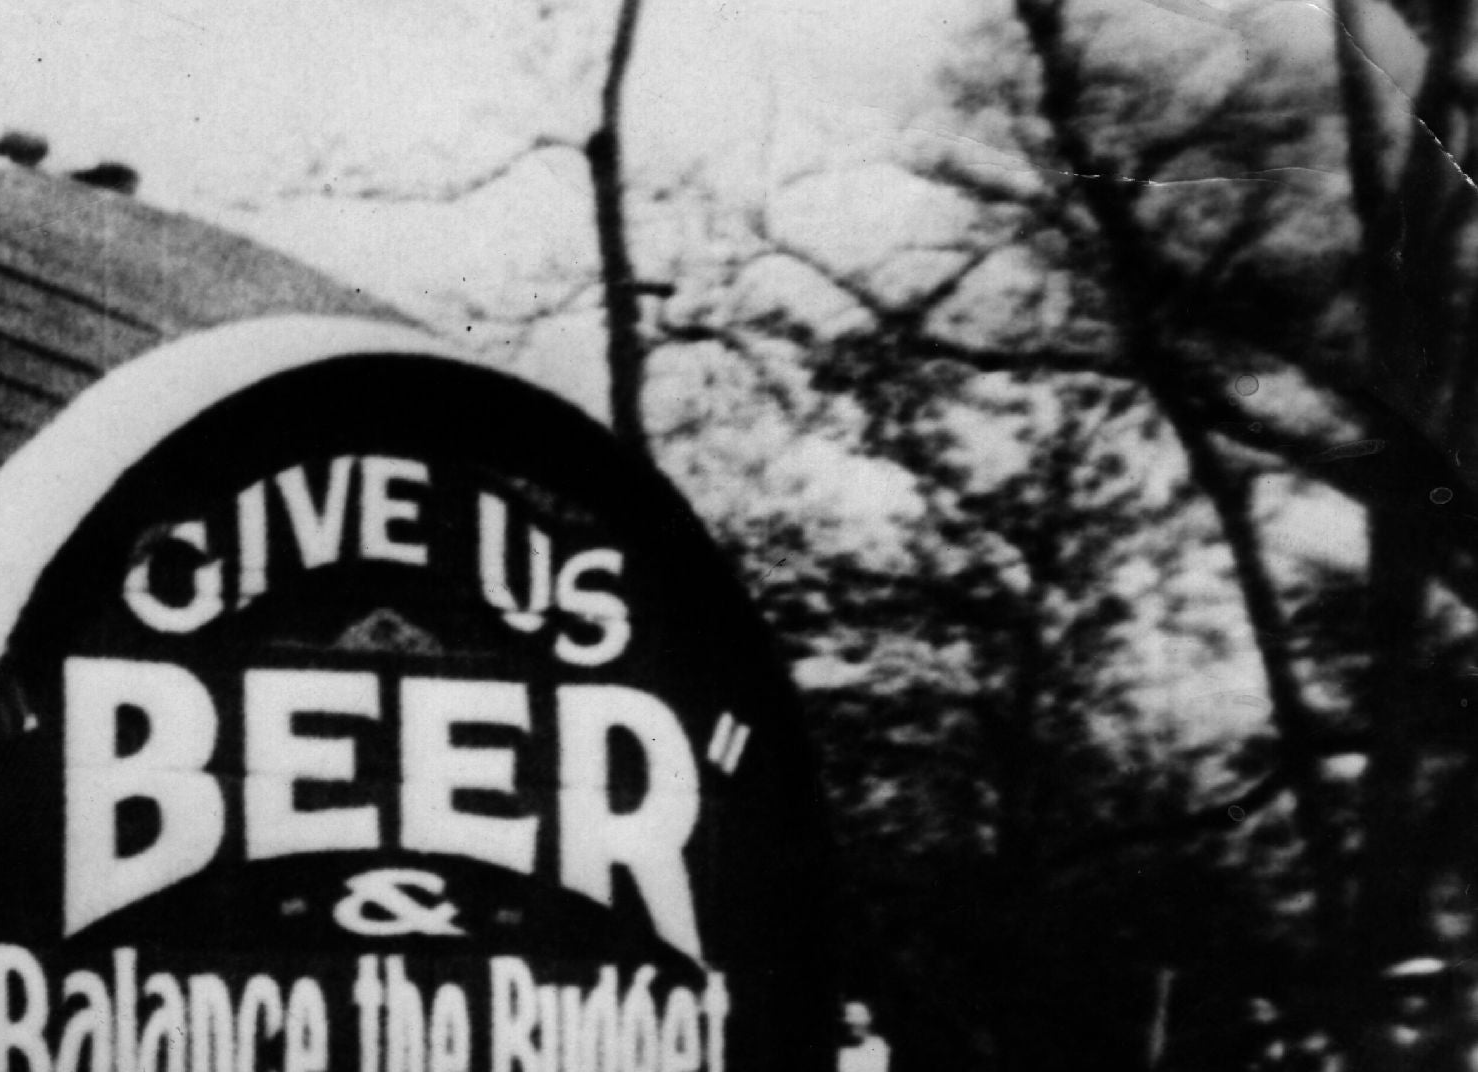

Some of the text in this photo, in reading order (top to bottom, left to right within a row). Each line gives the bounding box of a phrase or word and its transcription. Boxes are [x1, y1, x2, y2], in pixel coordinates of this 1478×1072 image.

[122, 453, 633, 667] GIVE US
[330, 867, 470, 937] &
